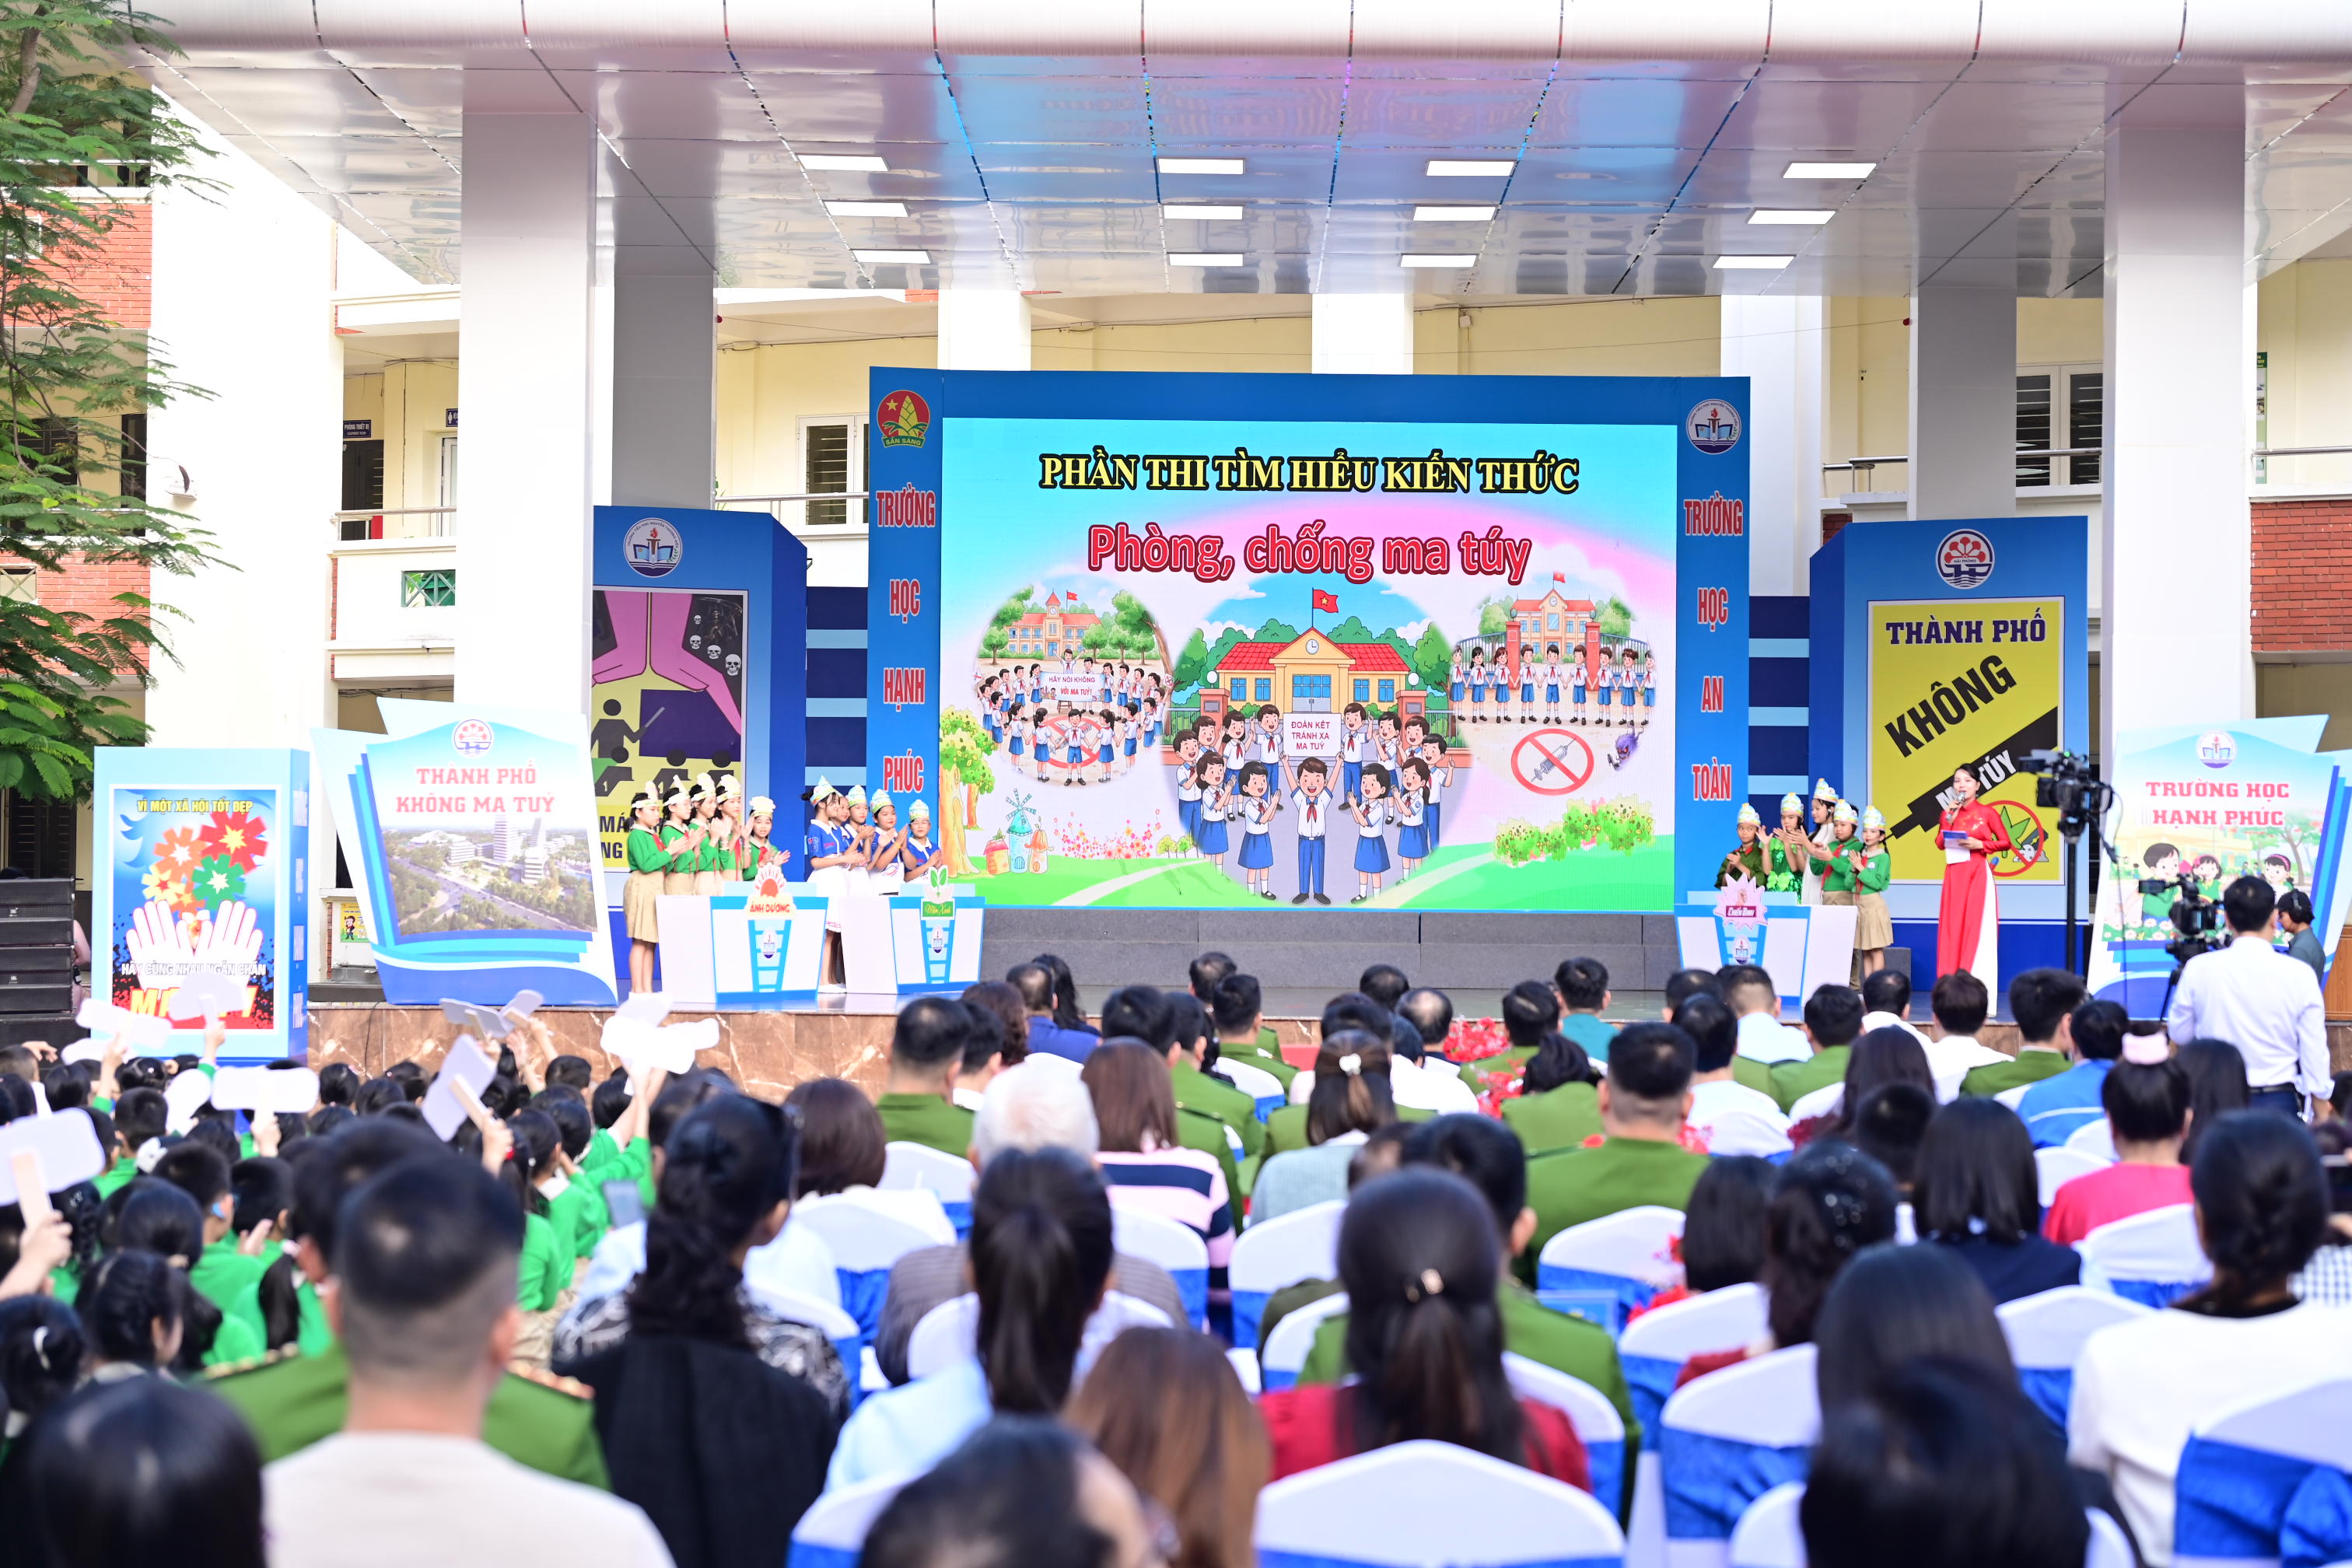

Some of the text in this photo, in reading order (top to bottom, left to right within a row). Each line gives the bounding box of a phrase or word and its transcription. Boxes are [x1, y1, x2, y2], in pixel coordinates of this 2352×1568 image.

[1039, 446, 1580, 494] PHẦN THI TÌM HIỂU KIẾN THỨC
[877, 482, 936, 528] TRƯỜNG
[1684, 491, 1743, 536] TRƯỜNG
[1088, 520, 1533, 586] Phòng, chống ma túy
[890, 579, 920, 624] HỌC
[1697, 586, 1728, 632] HỌC
[1885, 607, 2046, 645] THÀNH PHỐ
[884, 667, 925, 712] HẠNH
[1701, 675, 1724, 712] AN
[1885, 655, 2017, 758] KHÔNG
[1291, 719, 1330, 729] ĐOÀN KẾT
[1291, 730, 1318, 740] TRÁNH
[1296, 742, 1307, 751] MA
[416, 759, 536, 784] THÀNH PHỐ
[883, 748, 924, 793] PHÚC
[1692, 756, 1732, 801] TOÀN
[1978, 749, 2017, 790] TÚY
[137, 796, 254, 814] VÌ MỘT XÃ HỘI TỐT ĐẸP
[396, 792, 466, 813] KHÔNG
[473, 796, 506, 813] MA
[2145, 778, 2290, 802] TRƯỜNG HỌC
[2152, 806, 2284, 829] HẠNH PHÚC
[121, 960, 142, 975] HÃY
[145, 961, 173, 975] CÙNG
